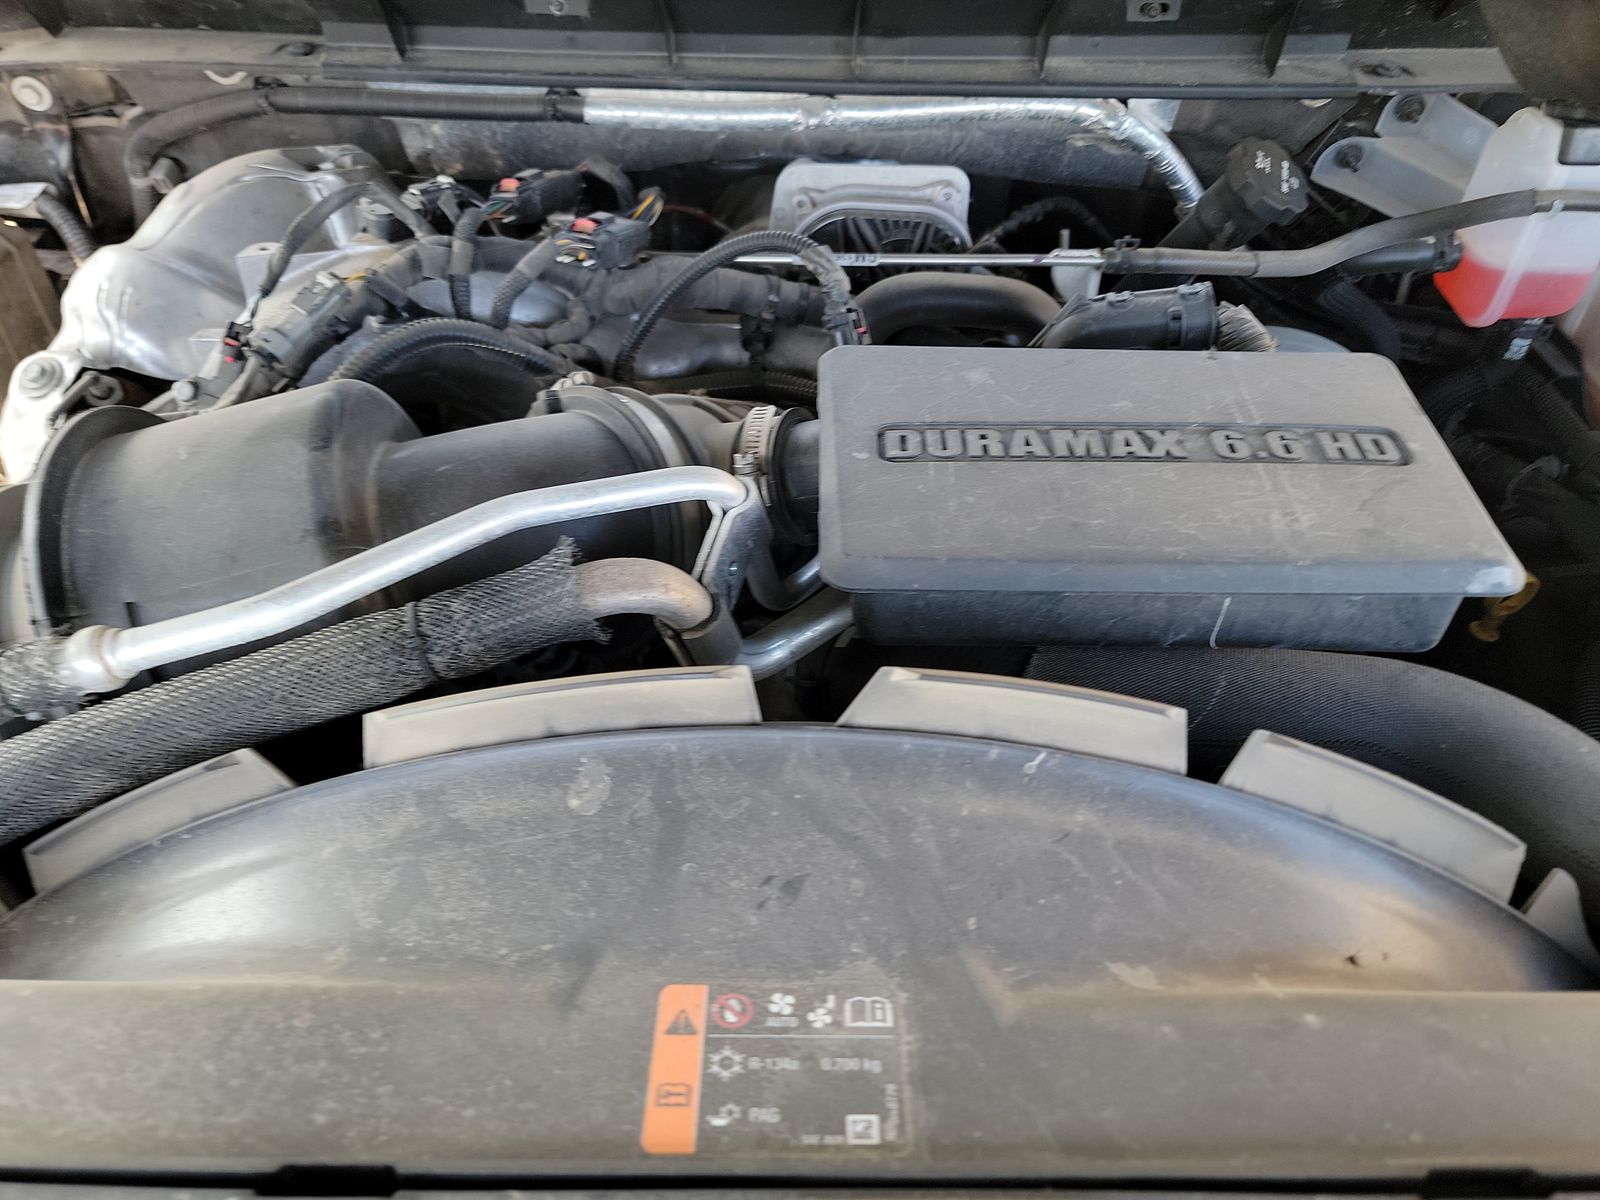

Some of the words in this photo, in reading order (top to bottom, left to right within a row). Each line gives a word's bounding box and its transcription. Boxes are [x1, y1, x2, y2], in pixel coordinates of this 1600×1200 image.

[883, 428, 1186, 460] DURAMAX
[1209, 429, 1305, 462] 6.6
[1314, 431, 1400, 463] HD
